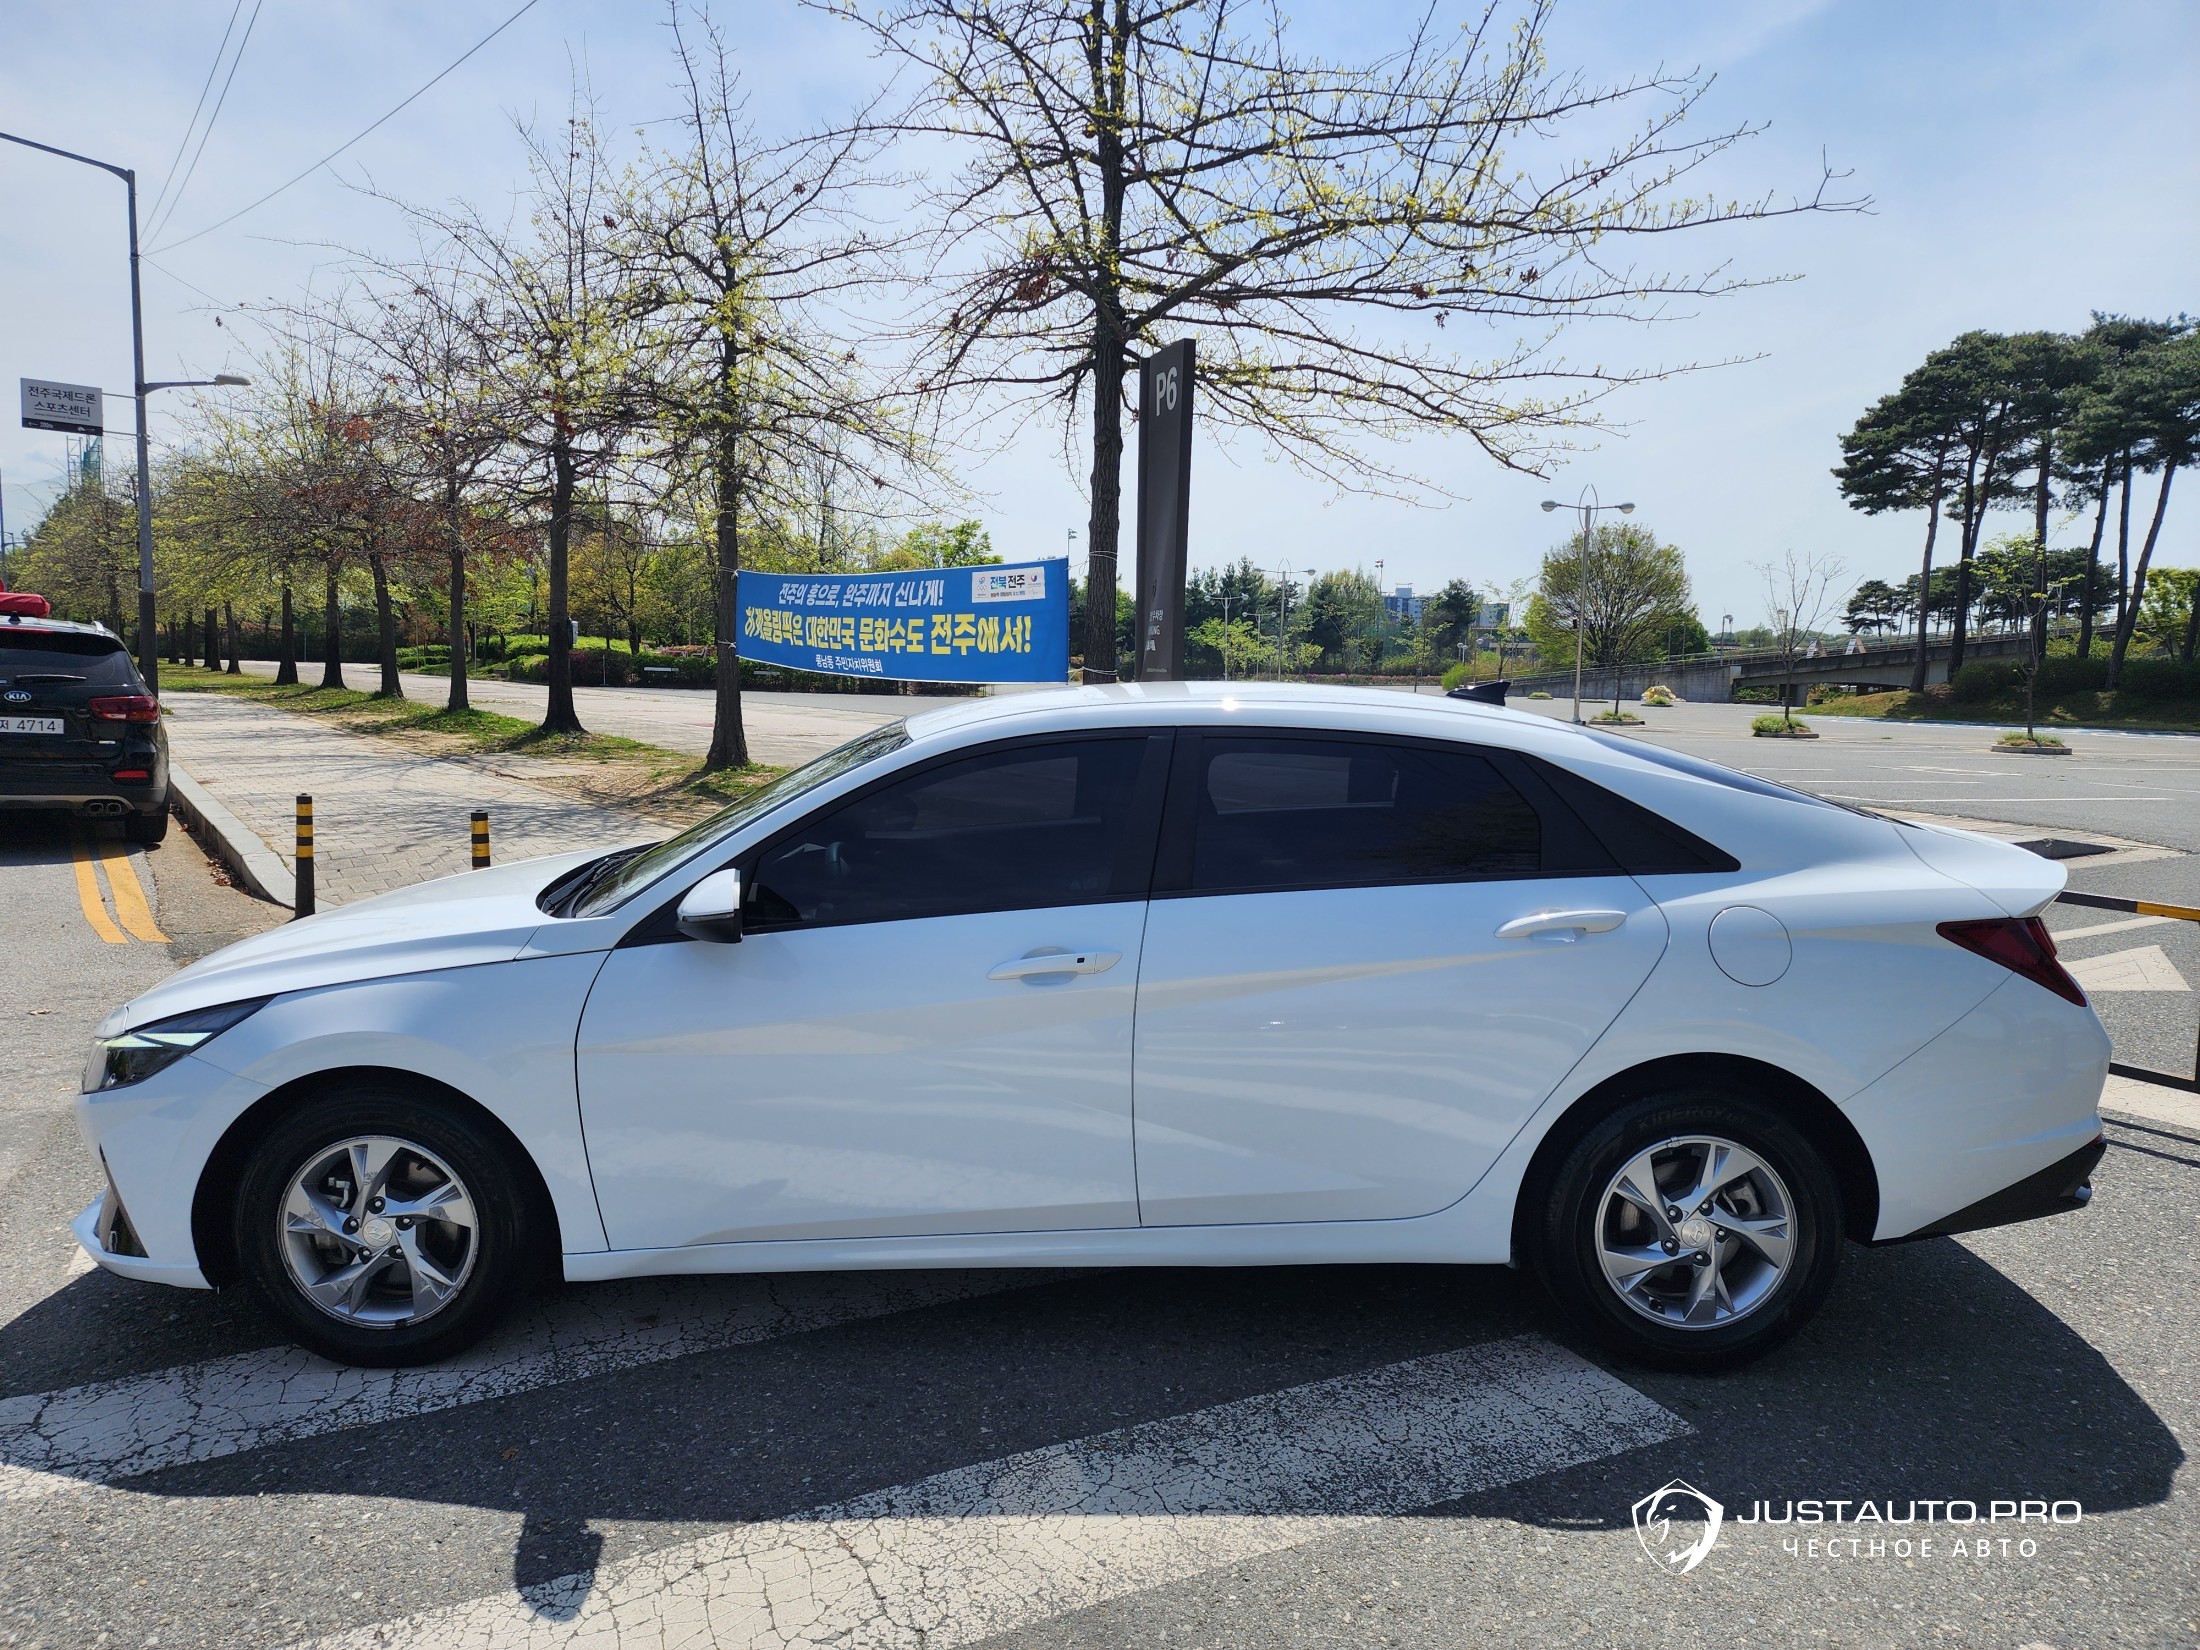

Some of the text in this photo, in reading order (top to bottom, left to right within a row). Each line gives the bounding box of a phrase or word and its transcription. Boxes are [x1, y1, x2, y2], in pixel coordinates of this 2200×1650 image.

[28, 386, 96, 405] 전주국제드론
[1156, 366, 1178, 417] P6
[34, 401, 91, 417] 스포츠센터
[990, 576, 1006, 590] 전북
[1008, 574, 1026, 588] 전주
[779, 579, 945, 608] 전주의 흥으로, 완주까지 신나게!
[744, 606, 1032, 656] 하계올림픽은 대한민국 문화수도 전주에서!
[815, 654, 883, 673] 풍남동 주민자치위원회
[17, 720, 56, 732] 4714
